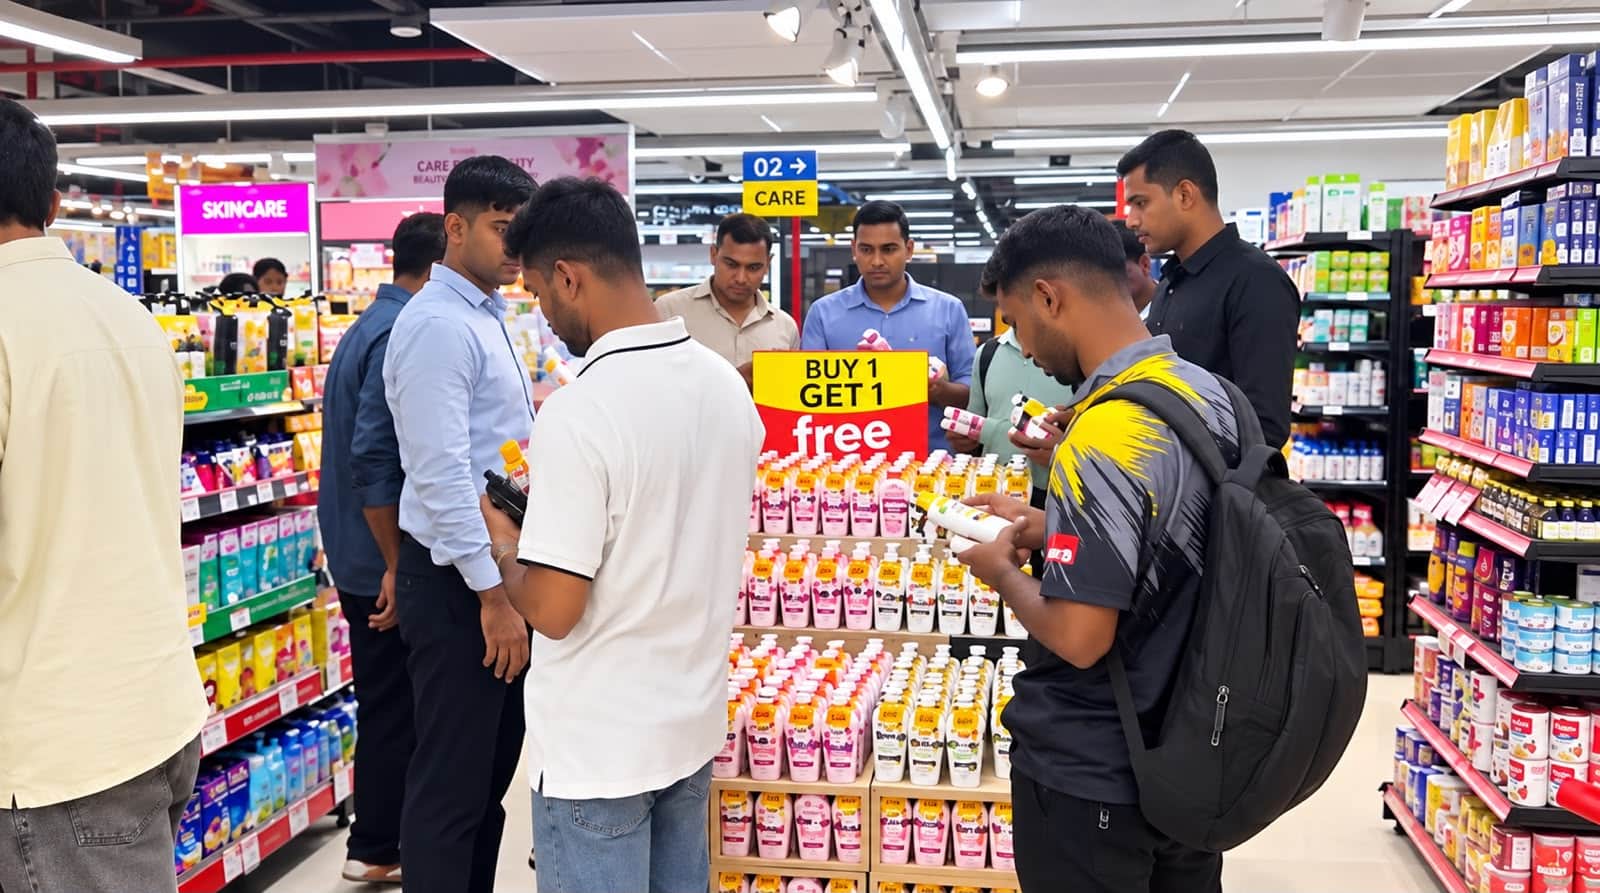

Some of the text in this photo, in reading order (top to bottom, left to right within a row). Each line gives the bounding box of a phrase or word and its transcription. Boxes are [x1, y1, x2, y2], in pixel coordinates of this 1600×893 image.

[416, 160, 449, 172] CARE
[754, 157, 783, 177] 02
[754, 190, 806, 206] CARE
[202, 200, 288, 219] SKINCARE
[806, 358, 877, 379] BUY 1
[800, 382, 882, 408] GET 1
[792, 415, 892, 455] free
